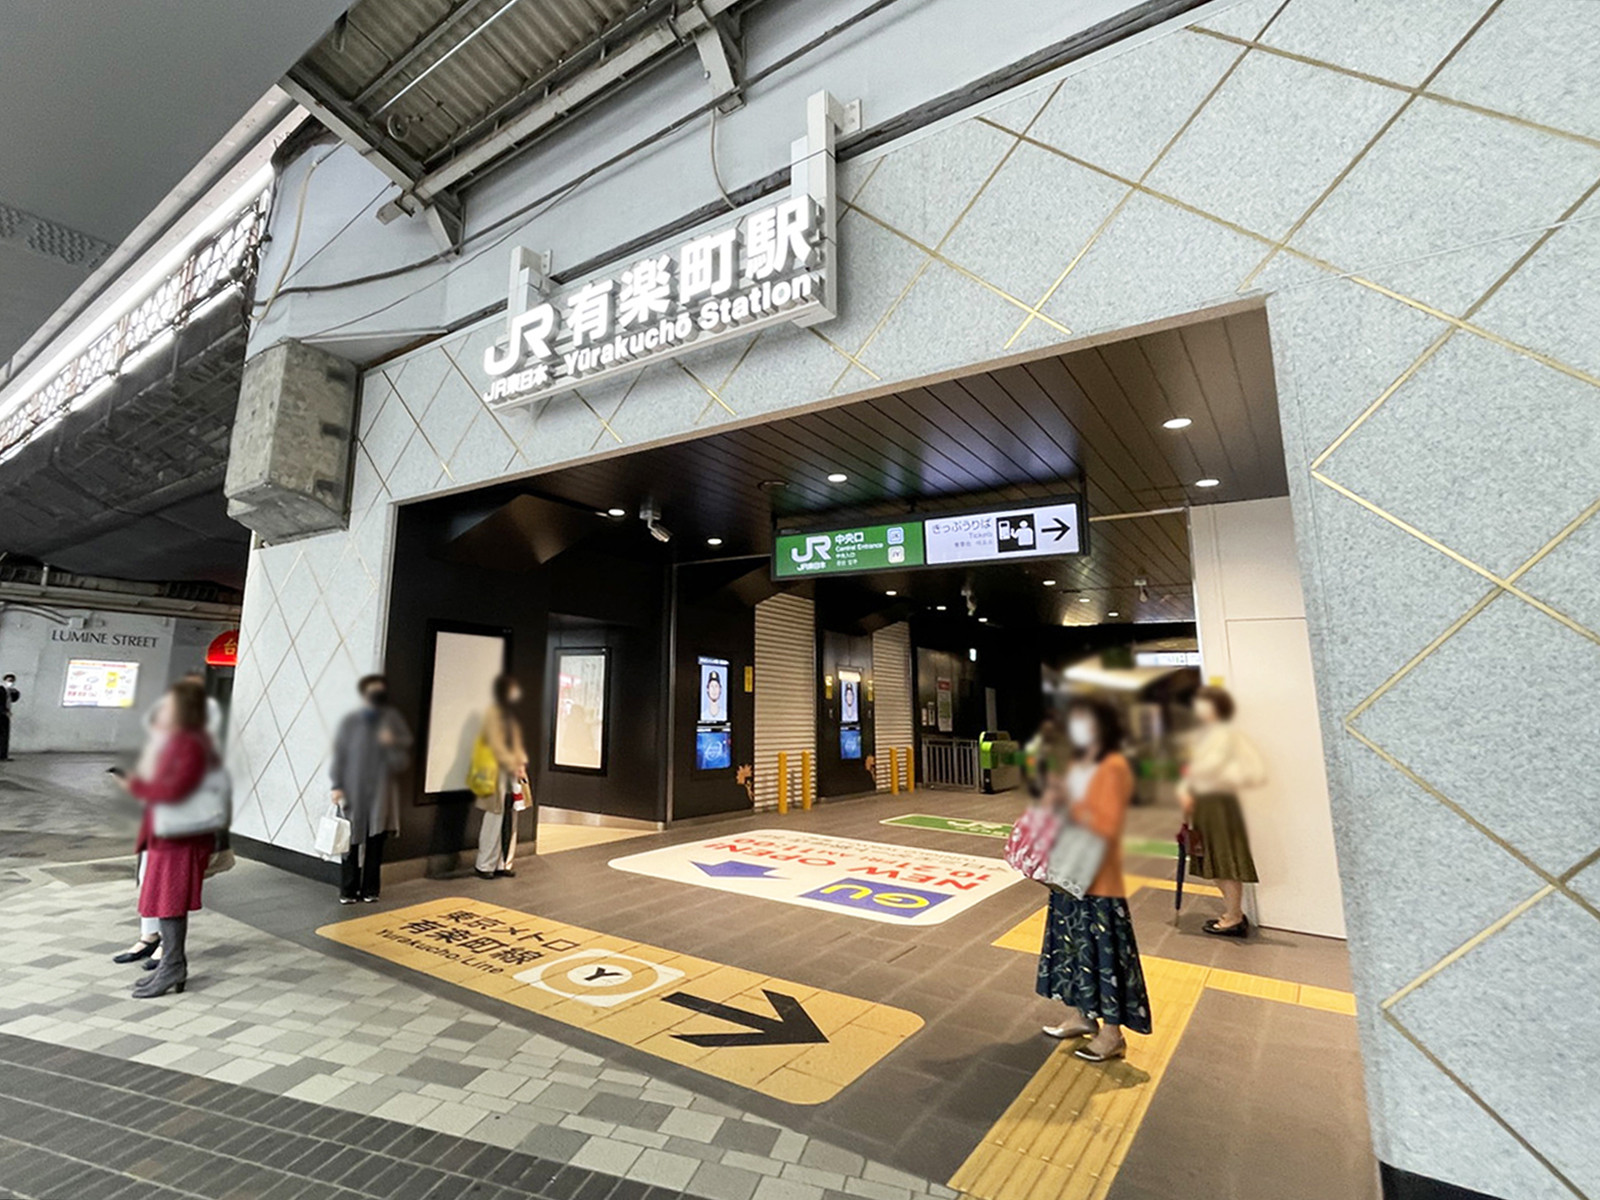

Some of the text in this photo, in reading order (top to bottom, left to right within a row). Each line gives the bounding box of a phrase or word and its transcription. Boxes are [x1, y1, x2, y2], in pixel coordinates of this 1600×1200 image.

[483, 193, 813, 376] JR 有楽町駅
[699, 273, 812, 331] Station
[483, 364, 549, 402] JR東日本
[834, 531, 865, 545] 中央口
[932, 518, 992, 535] きっぷうりば
[791, 535, 832, 562] JR
[835, 542, 884, 553] Central Entrance
[51, 629, 160, 649] LUMINE STREET
[846, 866, 980, 891] NEW
[818, 883, 930, 909] GU
[399, 918, 546, 965] 有楽町線
[437, 910, 581, 952] 東京メトロ
[376, 928, 505, 975] Yurakucho Line
[583, 966, 622, 982] Y
